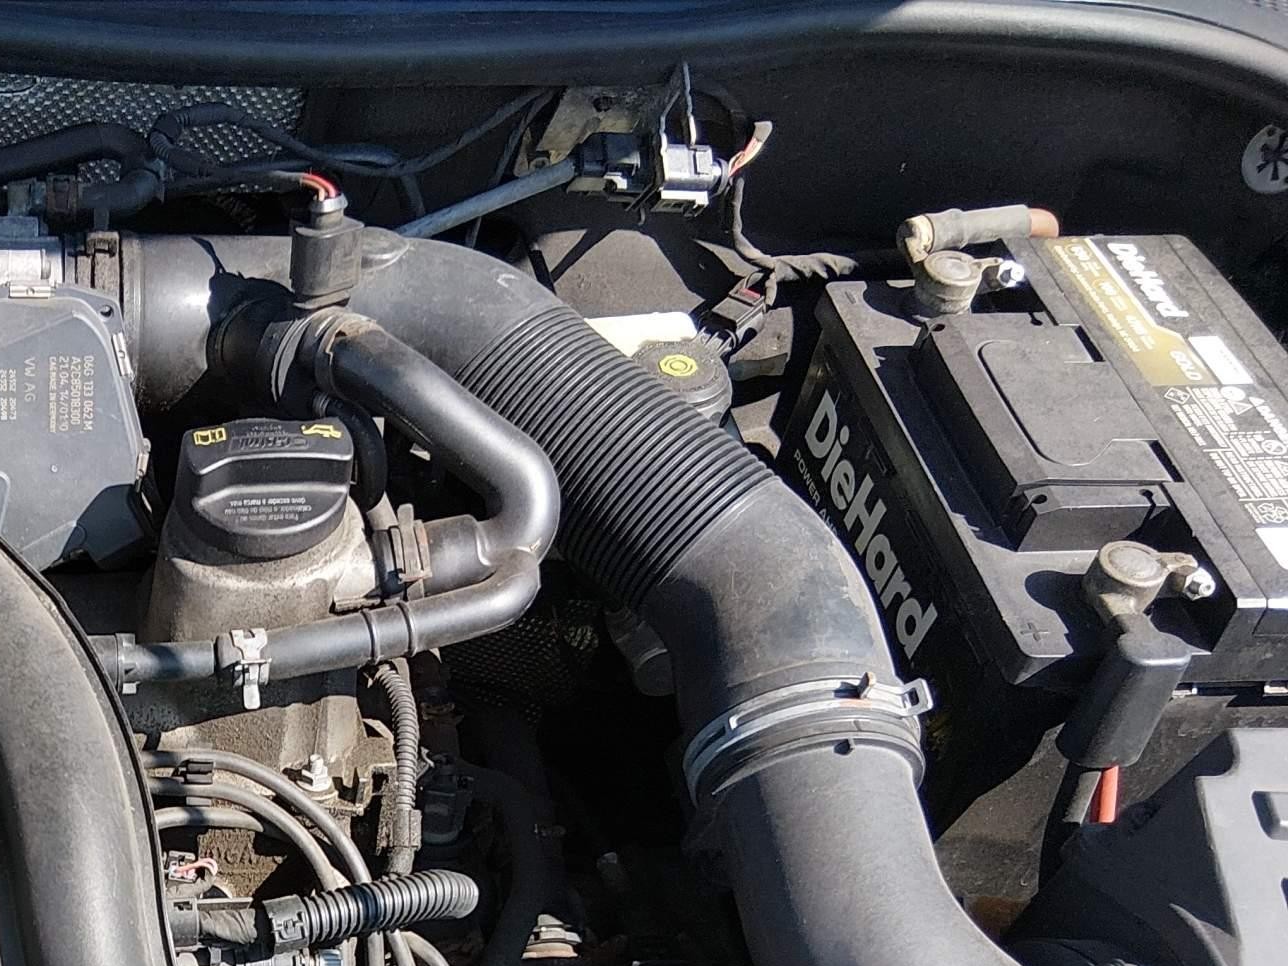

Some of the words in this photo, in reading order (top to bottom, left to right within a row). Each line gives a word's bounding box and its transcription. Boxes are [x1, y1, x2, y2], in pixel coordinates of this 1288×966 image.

[1107, 242, 1189, 318] DieHard
[24, 357, 35, 376] VW
[24, 382, 36, 402] AG
[83, 381, 93, 396] 133
[793, 448, 820, 506] POWER
[804, 388, 938, 660] DieHard
